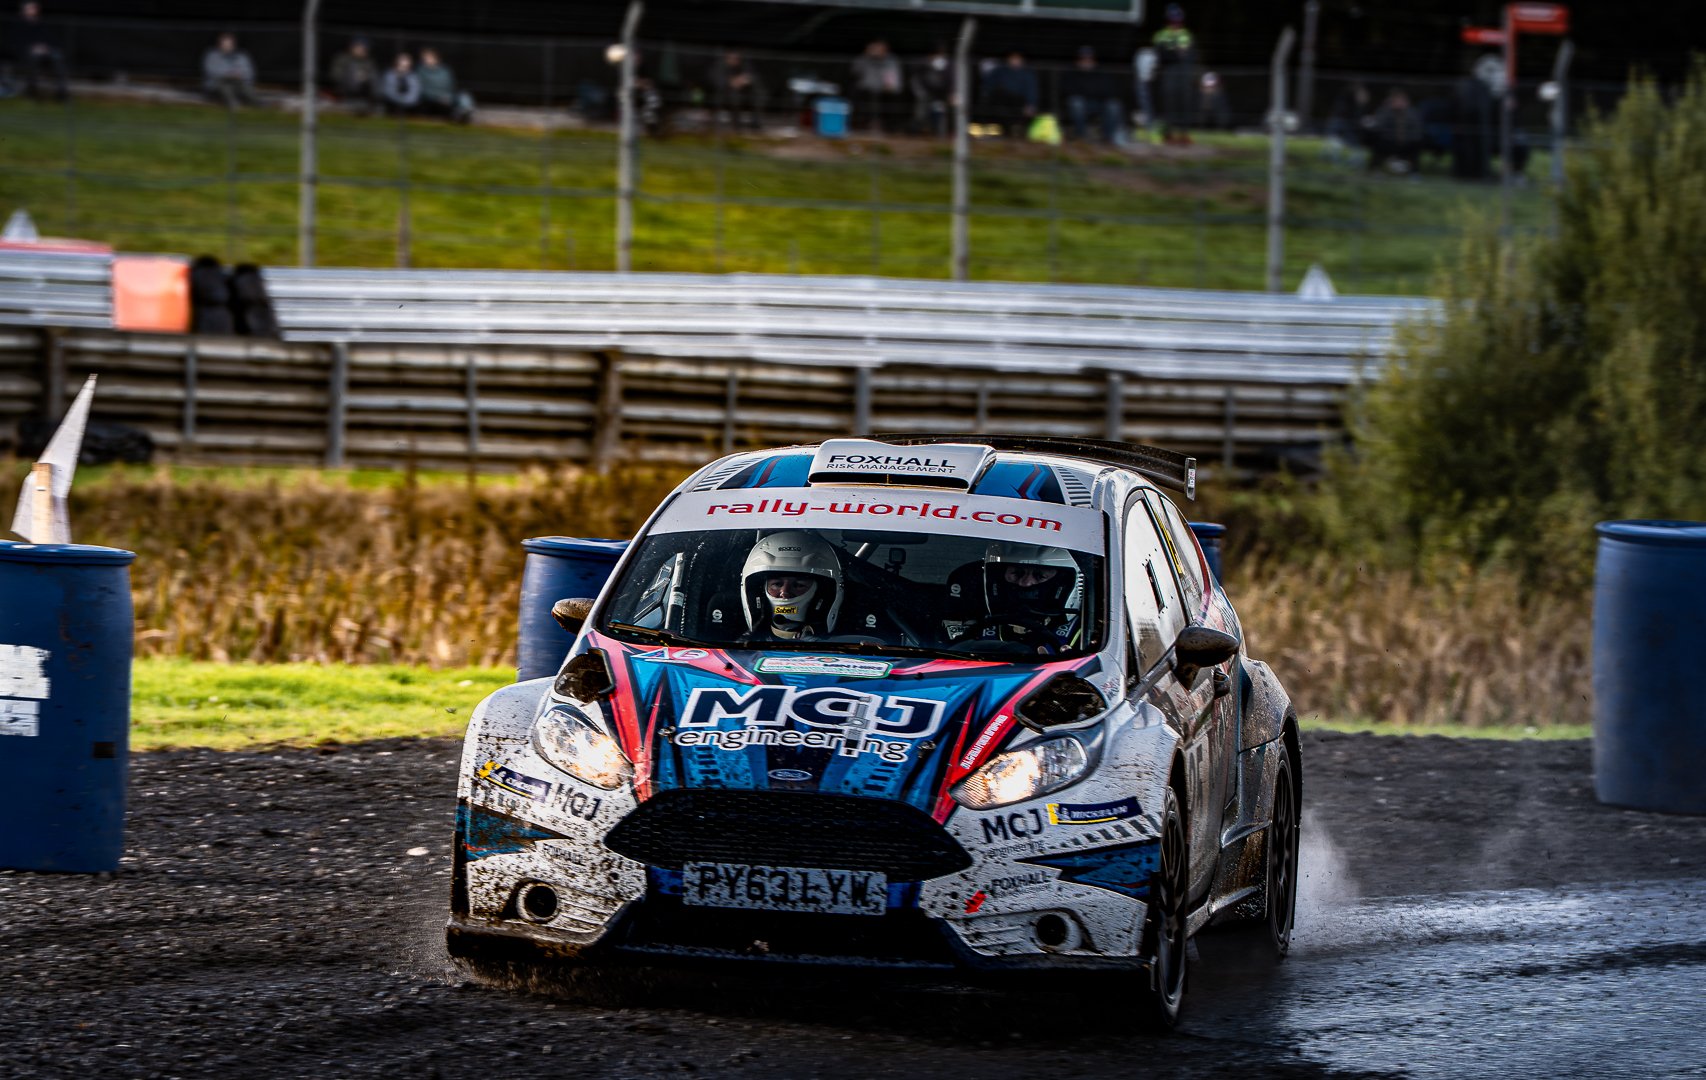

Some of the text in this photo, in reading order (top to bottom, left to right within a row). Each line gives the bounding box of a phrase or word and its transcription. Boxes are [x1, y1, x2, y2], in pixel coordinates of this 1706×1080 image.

[829, 455, 956, 469] FOXHALL
[858, 463, 955, 474] MANAGEMENT
[706, 498, 1063, 533] rally-world.com
[674, 726, 912, 763] engineering
